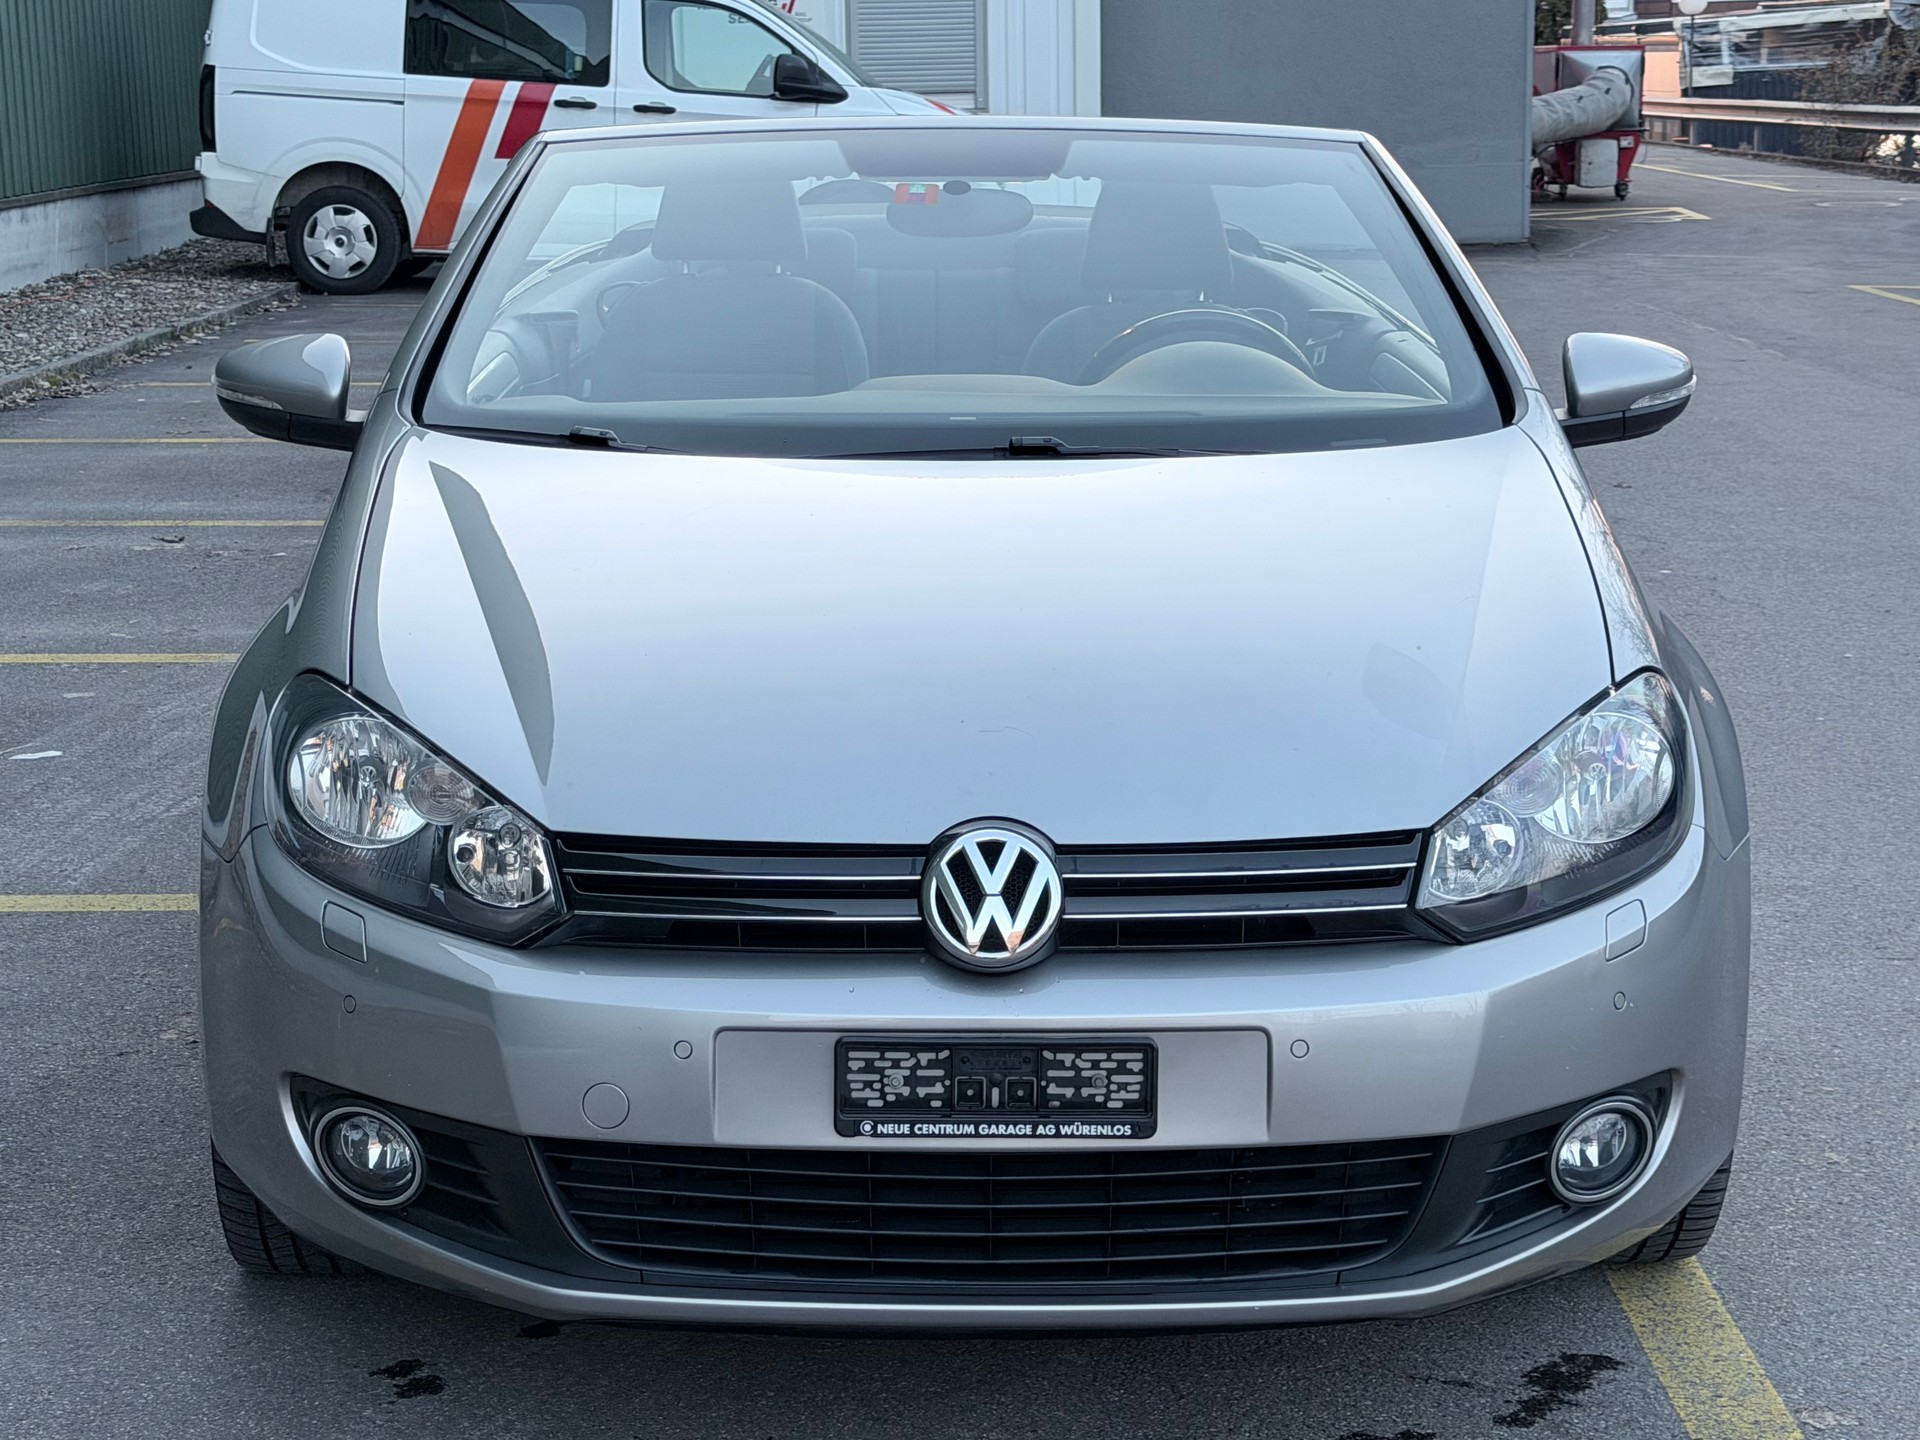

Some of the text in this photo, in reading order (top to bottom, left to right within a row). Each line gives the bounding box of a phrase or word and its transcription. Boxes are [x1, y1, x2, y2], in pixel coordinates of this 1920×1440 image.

[933, 831, 1058, 957] VW
[877, 1122, 1132, 1136] NEUE CENTRUM GARAGE AG WÜRENLOS
